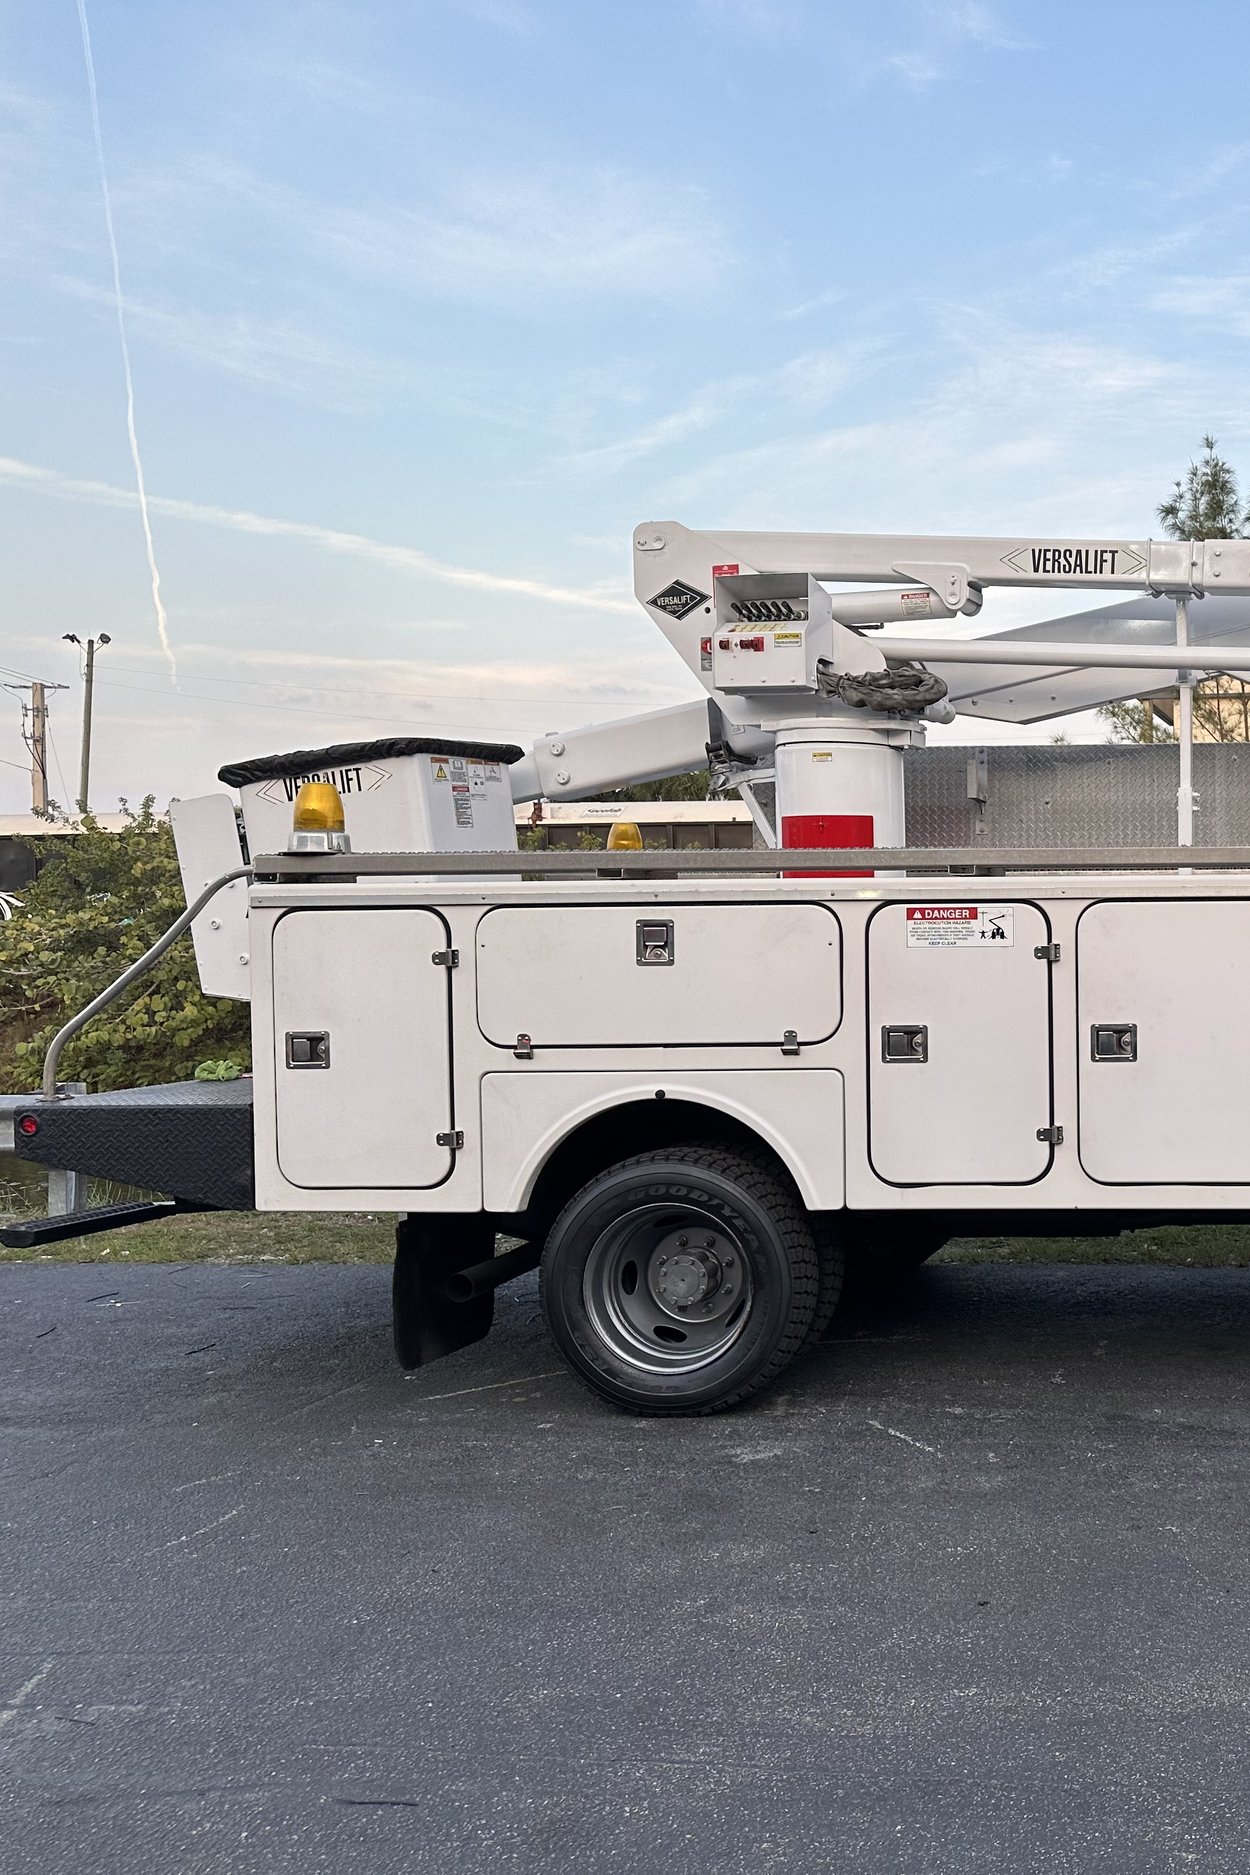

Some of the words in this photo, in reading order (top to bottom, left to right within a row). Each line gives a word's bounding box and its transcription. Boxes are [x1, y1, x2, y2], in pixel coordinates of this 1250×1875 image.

[1031, 548, 1119, 575] VERSALIFT
[656, 595, 691, 606] VERSALIFT
[924, 909, 970, 919] DANGER
